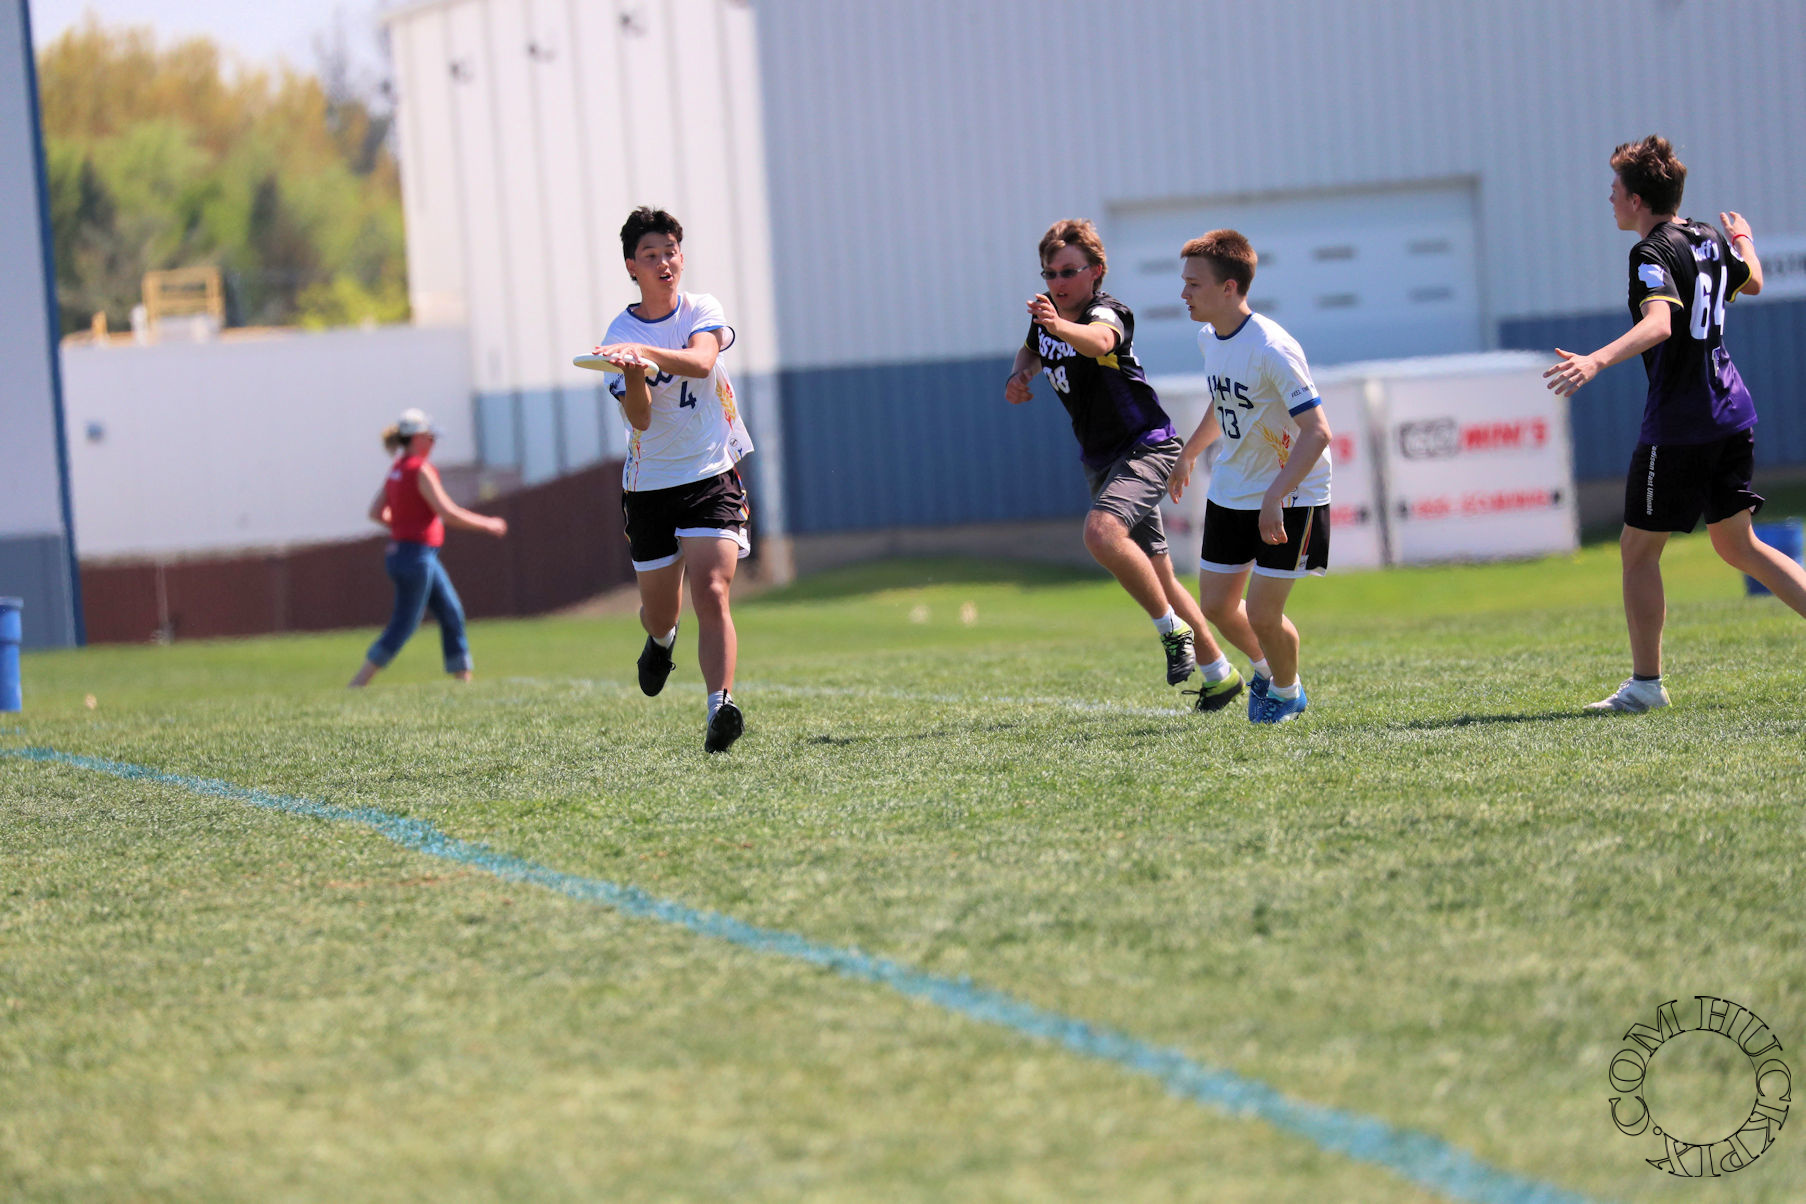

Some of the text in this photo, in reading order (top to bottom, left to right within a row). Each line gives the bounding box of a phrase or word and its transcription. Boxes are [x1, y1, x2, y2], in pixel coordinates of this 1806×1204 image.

[679, 380, 697, 410] 4
[1217, 405, 1241, 440] 13
[1649, 445, 1658, 471] adison
[1646, 487, 1654, 516] Ultimate
